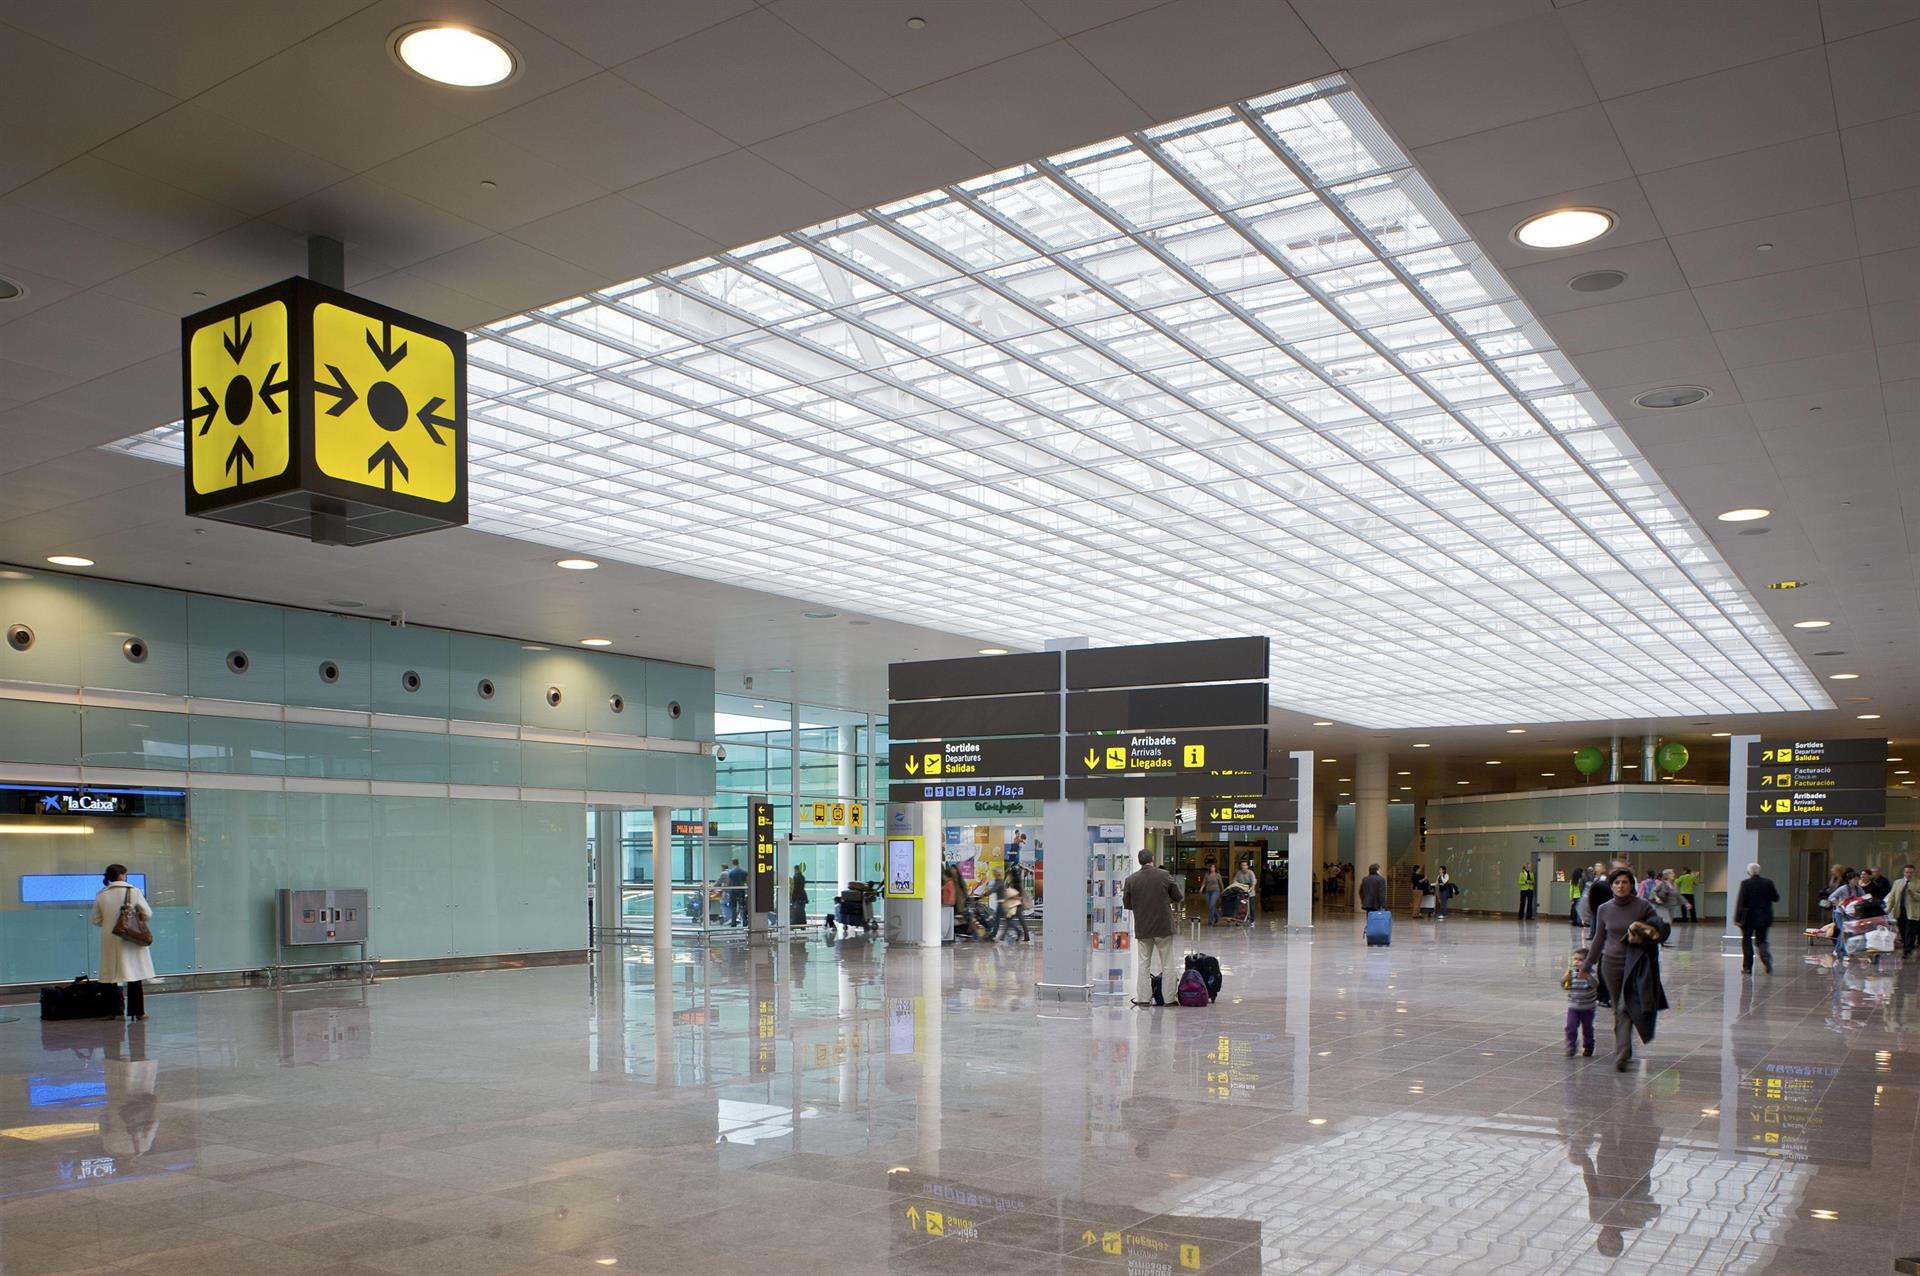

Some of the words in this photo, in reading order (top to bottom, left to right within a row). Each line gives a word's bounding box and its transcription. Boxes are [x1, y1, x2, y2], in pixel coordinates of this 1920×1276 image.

[1131, 736, 1176, 746] Arribades
[945, 743, 980, 753] Sortides
[1131, 748, 1162, 756] Arrivals
[945, 754, 981, 763] Departures
[1130, 758, 1172, 769] Llegadas
[945, 764, 976, 773] Salidas
[979, 786, 991, 796] La
[995, 785, 1024, 798] Plaça
[1833, 818, 1858, 827] Plaça
